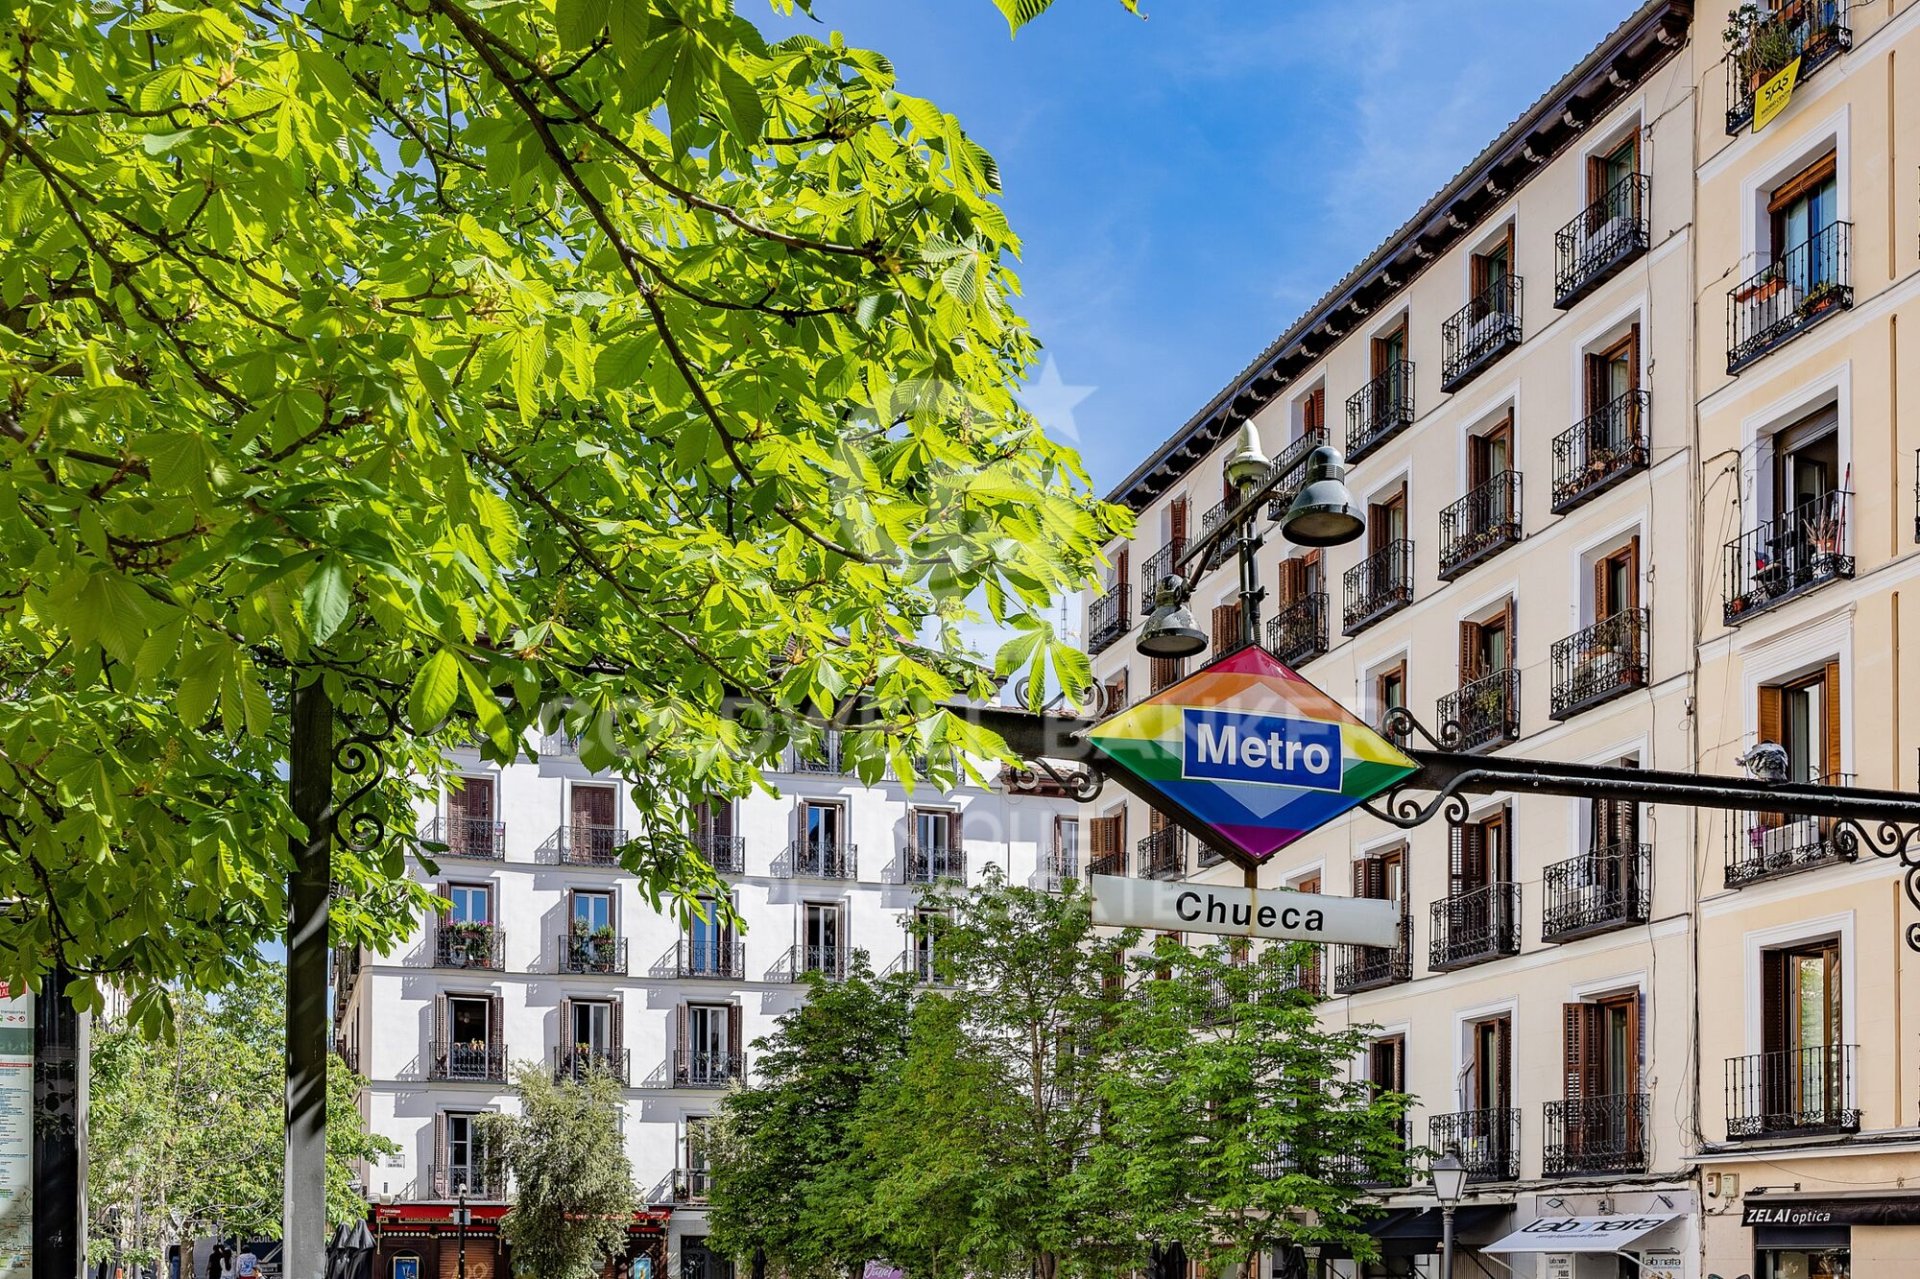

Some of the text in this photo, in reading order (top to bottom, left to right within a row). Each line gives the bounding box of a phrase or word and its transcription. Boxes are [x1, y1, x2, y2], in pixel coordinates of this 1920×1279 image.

[1197, 723, 1330, 774] Metro
[1175, 891, 1324, 932] Chueca
[1747, 1209, 1831, 1225] ZELAI optica
